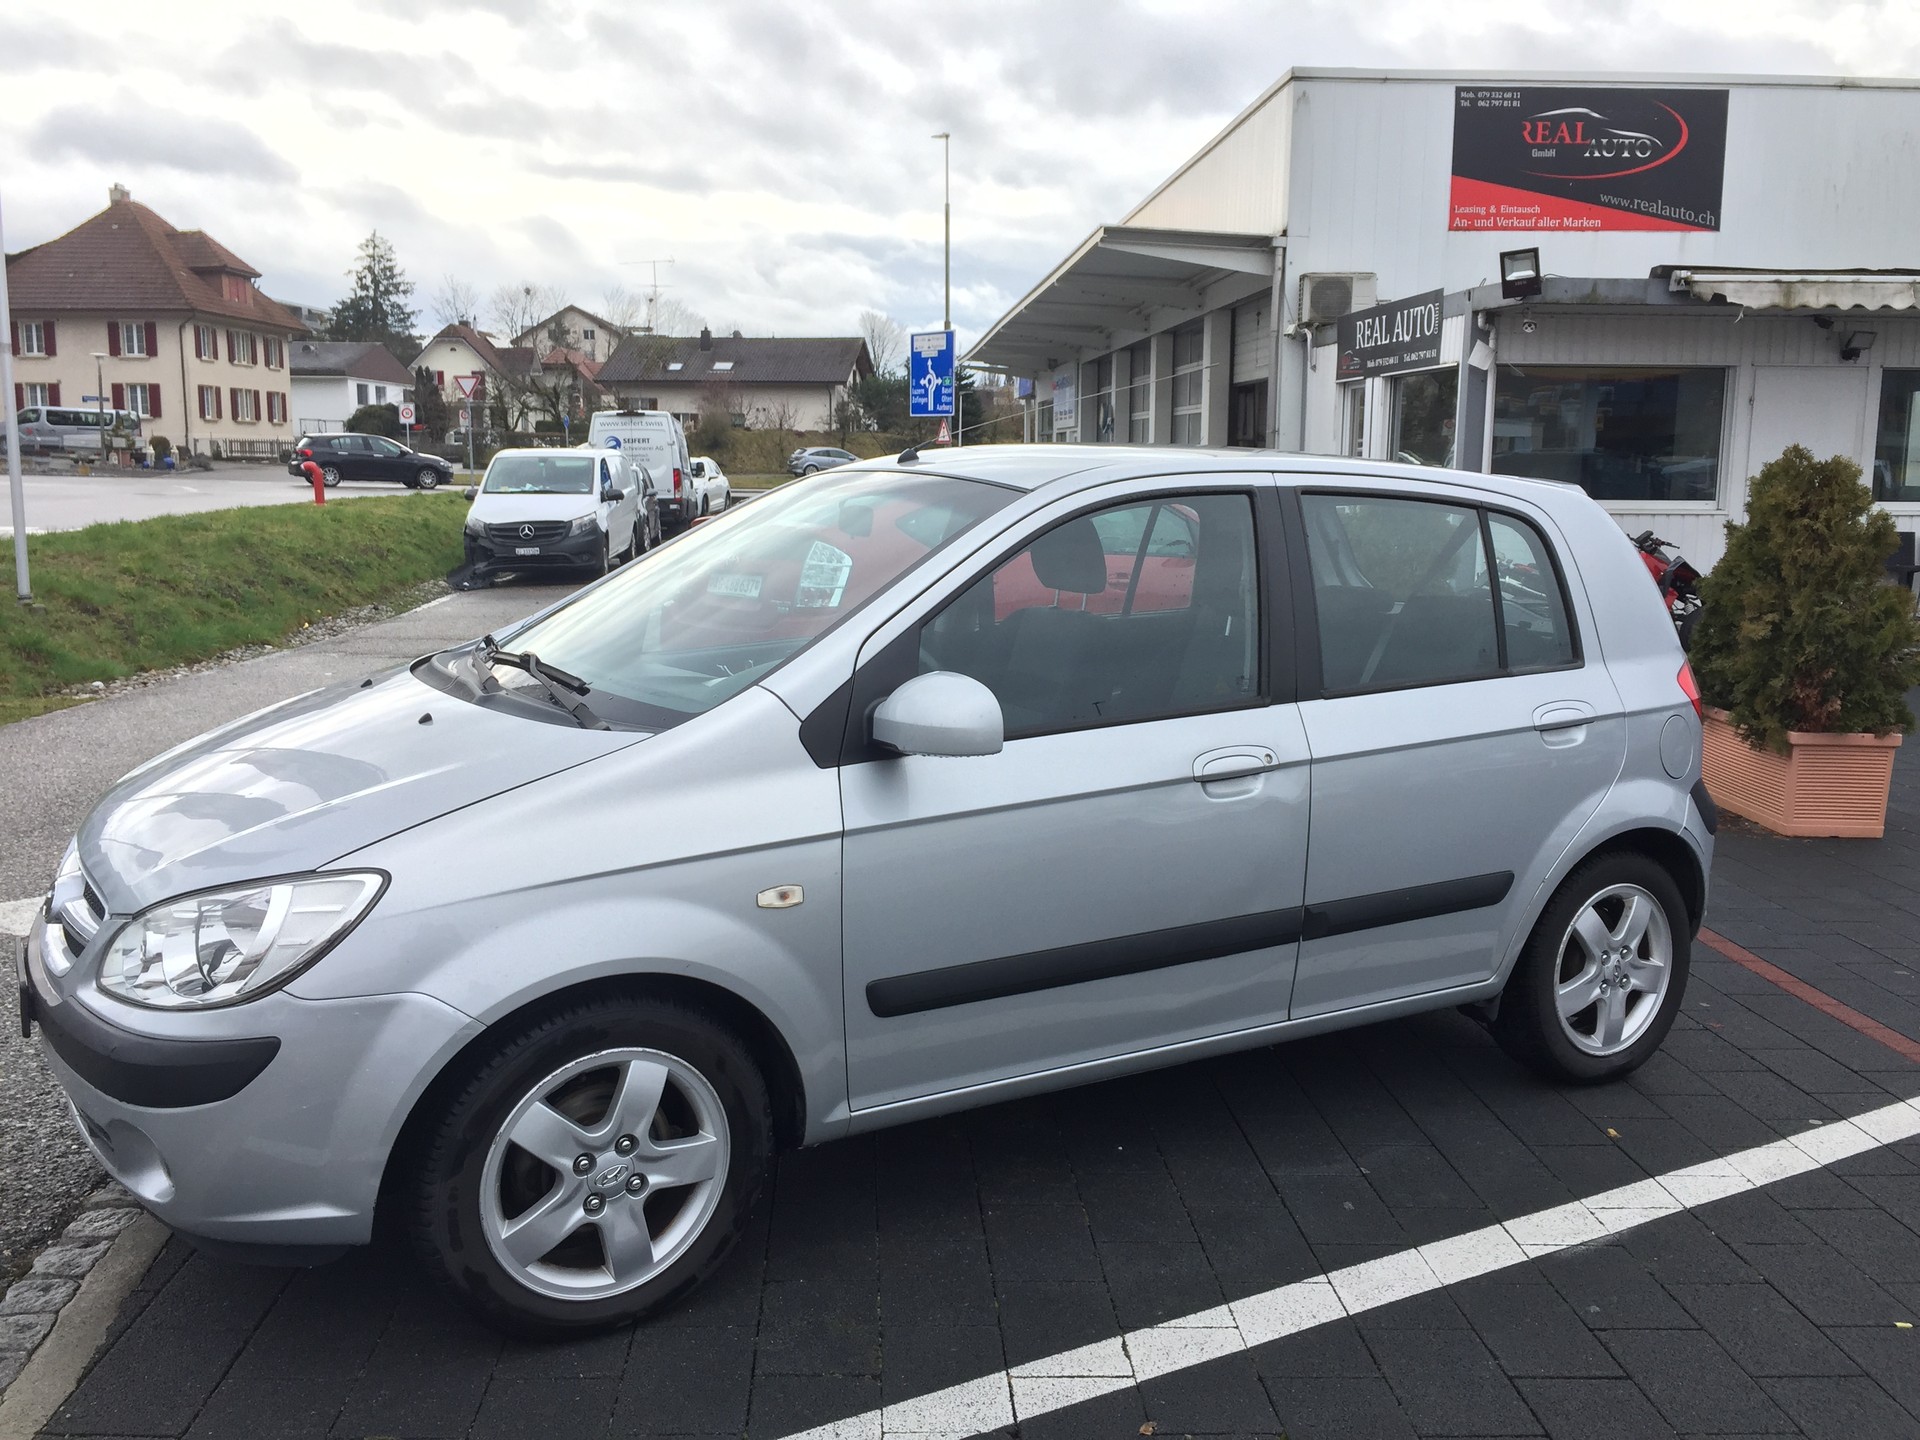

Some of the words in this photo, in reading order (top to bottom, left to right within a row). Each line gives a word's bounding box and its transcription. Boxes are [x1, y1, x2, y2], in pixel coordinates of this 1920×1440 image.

[1513, 91, 1521, 99] 11
[1522, 121, 1592, 144] REAL
[1531, 148, 1556, 157] GmbH
[1584, 138, 1652, 157] AUTO
[1454, 205, 1487, 214] Leasing
[1489, 205, 1497, 213] &
[1500, 204, 1541, 214] Eintausch
[1600, 193, 1715, 226] www.realauto.ch
[1453, 217, 1472, 227] An-
[1474, 217, 1494, 227] und
[1496, 216, 1536, 227] Verkauf
[1537, 216, 1561, 227] aller
[1563, 216, 1601, 227] Marken
[1356, 315, 1390, 350] REAL
[1392, 303, 1435, 343] AUTO
